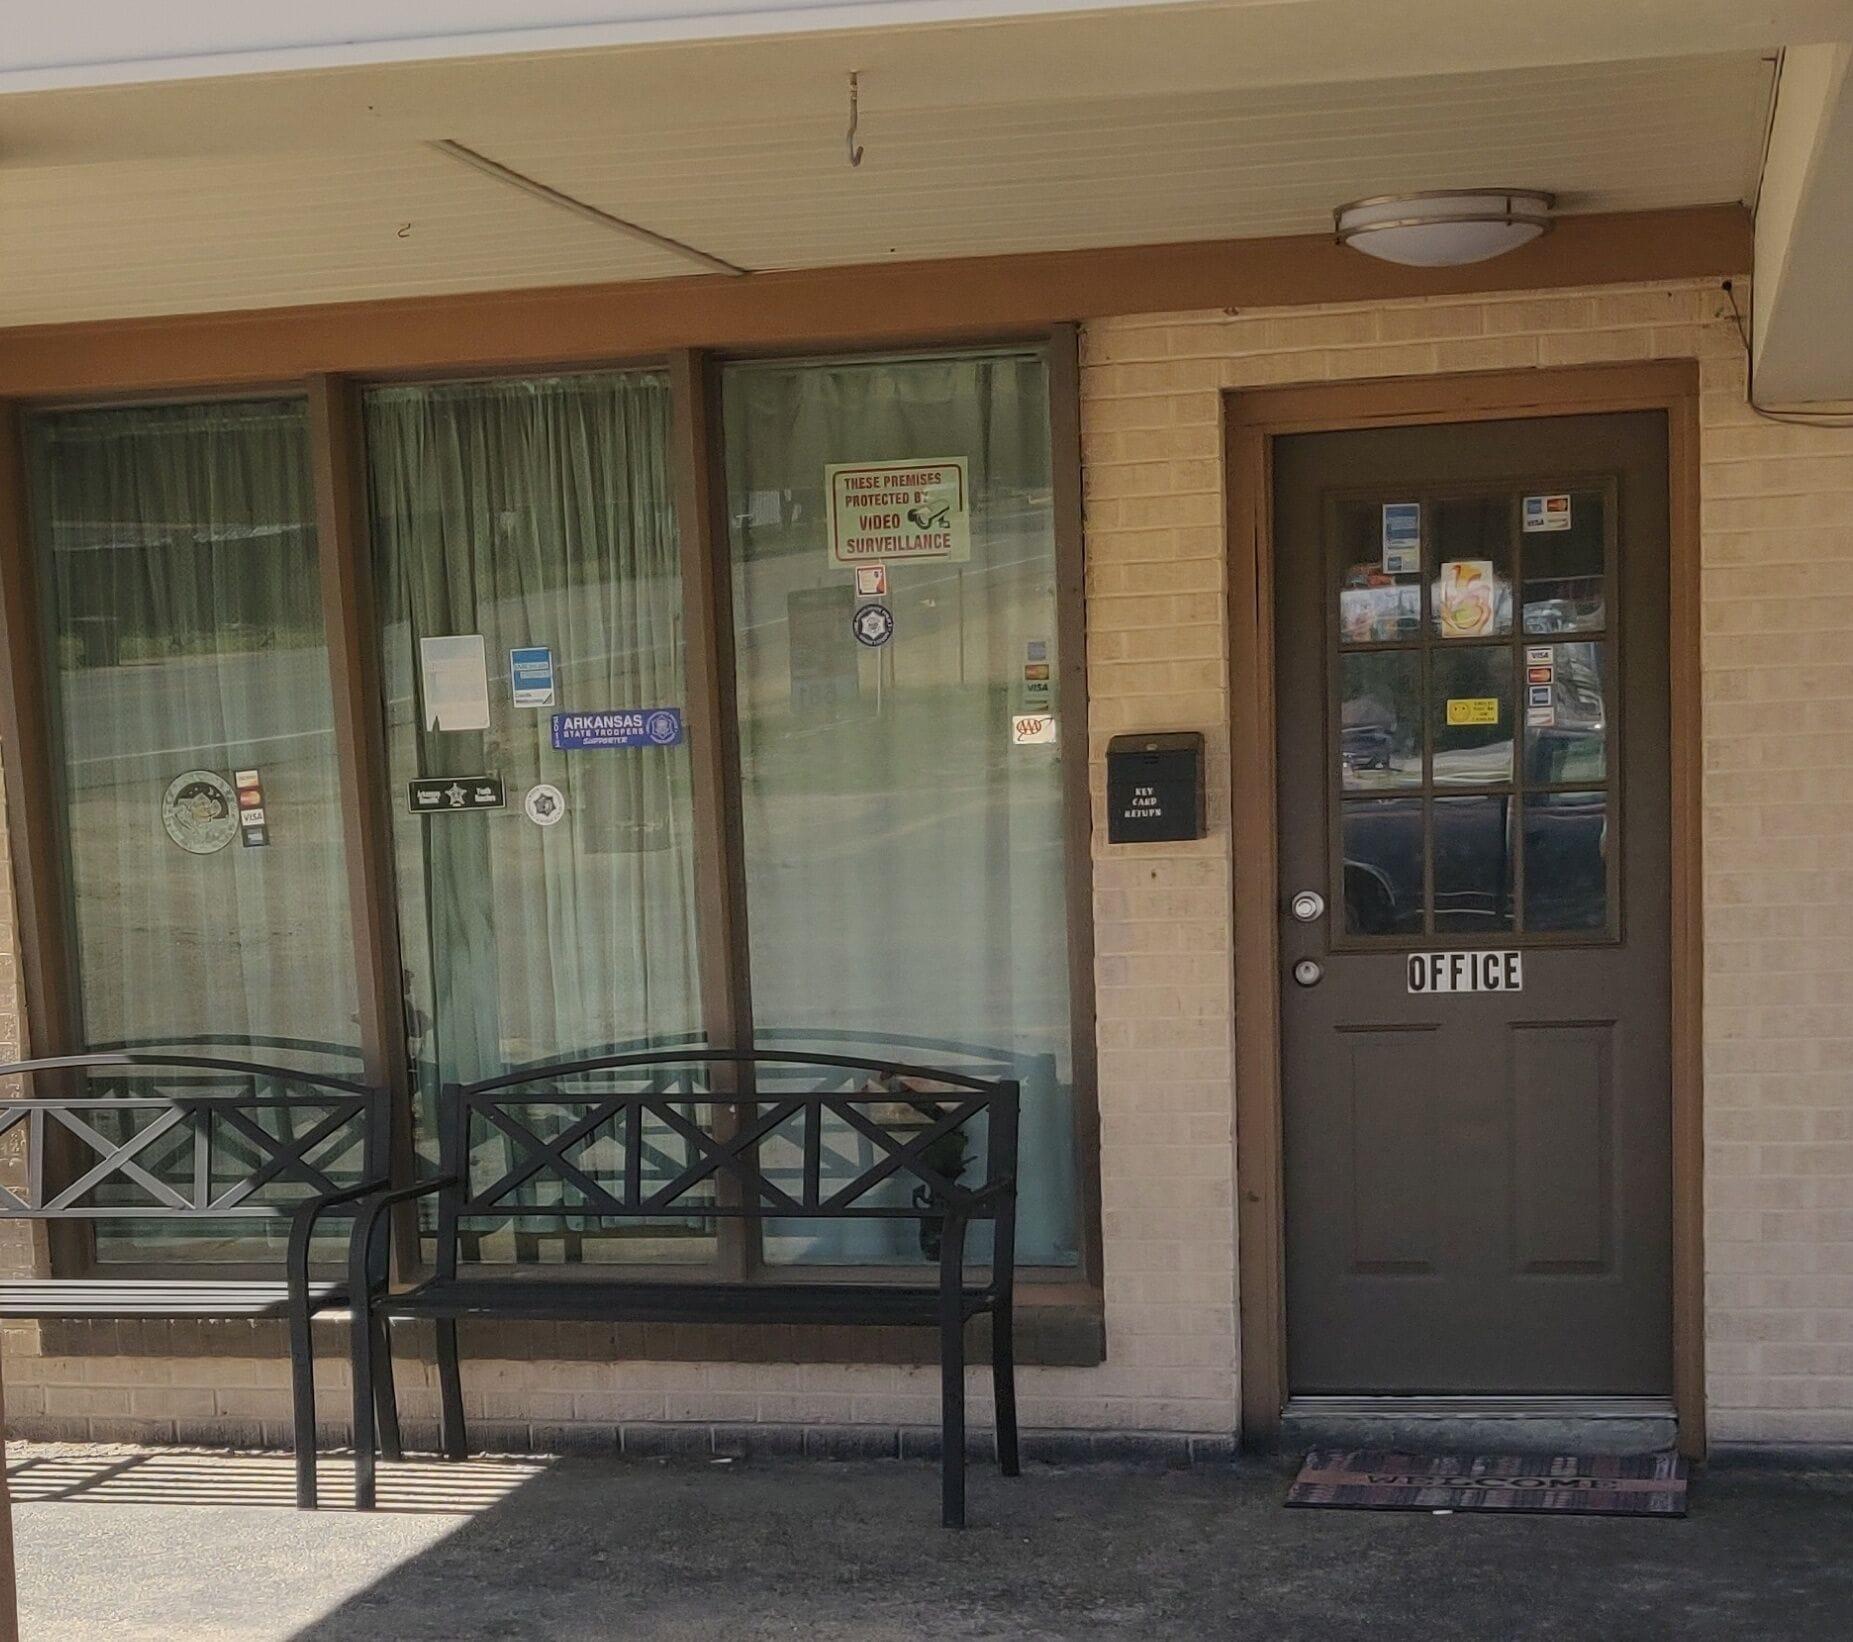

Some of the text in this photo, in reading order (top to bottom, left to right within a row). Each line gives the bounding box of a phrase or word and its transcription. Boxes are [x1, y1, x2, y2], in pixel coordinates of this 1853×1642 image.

[844, 473, 942, 490] THESE PREMISES
[845, 491, 929, 508] PROTECTED BY
[859, 513, 900, 531] VIDEO
[847, 533, 951, 554] SURVEILLANCE
[1027, 683, 1049, 692] VISA
[563, 714, 643, 730] ARKANSAS
[1017, 719, 1042, 735] AAA
[563, 728, 644, 738] STATE TROOPERS
[1135, 787, 1154, 796] KEY
[1132, 797, 1157, 806] CARD
[244, 812, 263, 822] VISA
[1124, 808, 1162, 818] RETURN
[1409, 952, 1520, 991] OFFICE
[1367, 1475, 1617, 1489] WELCOME
